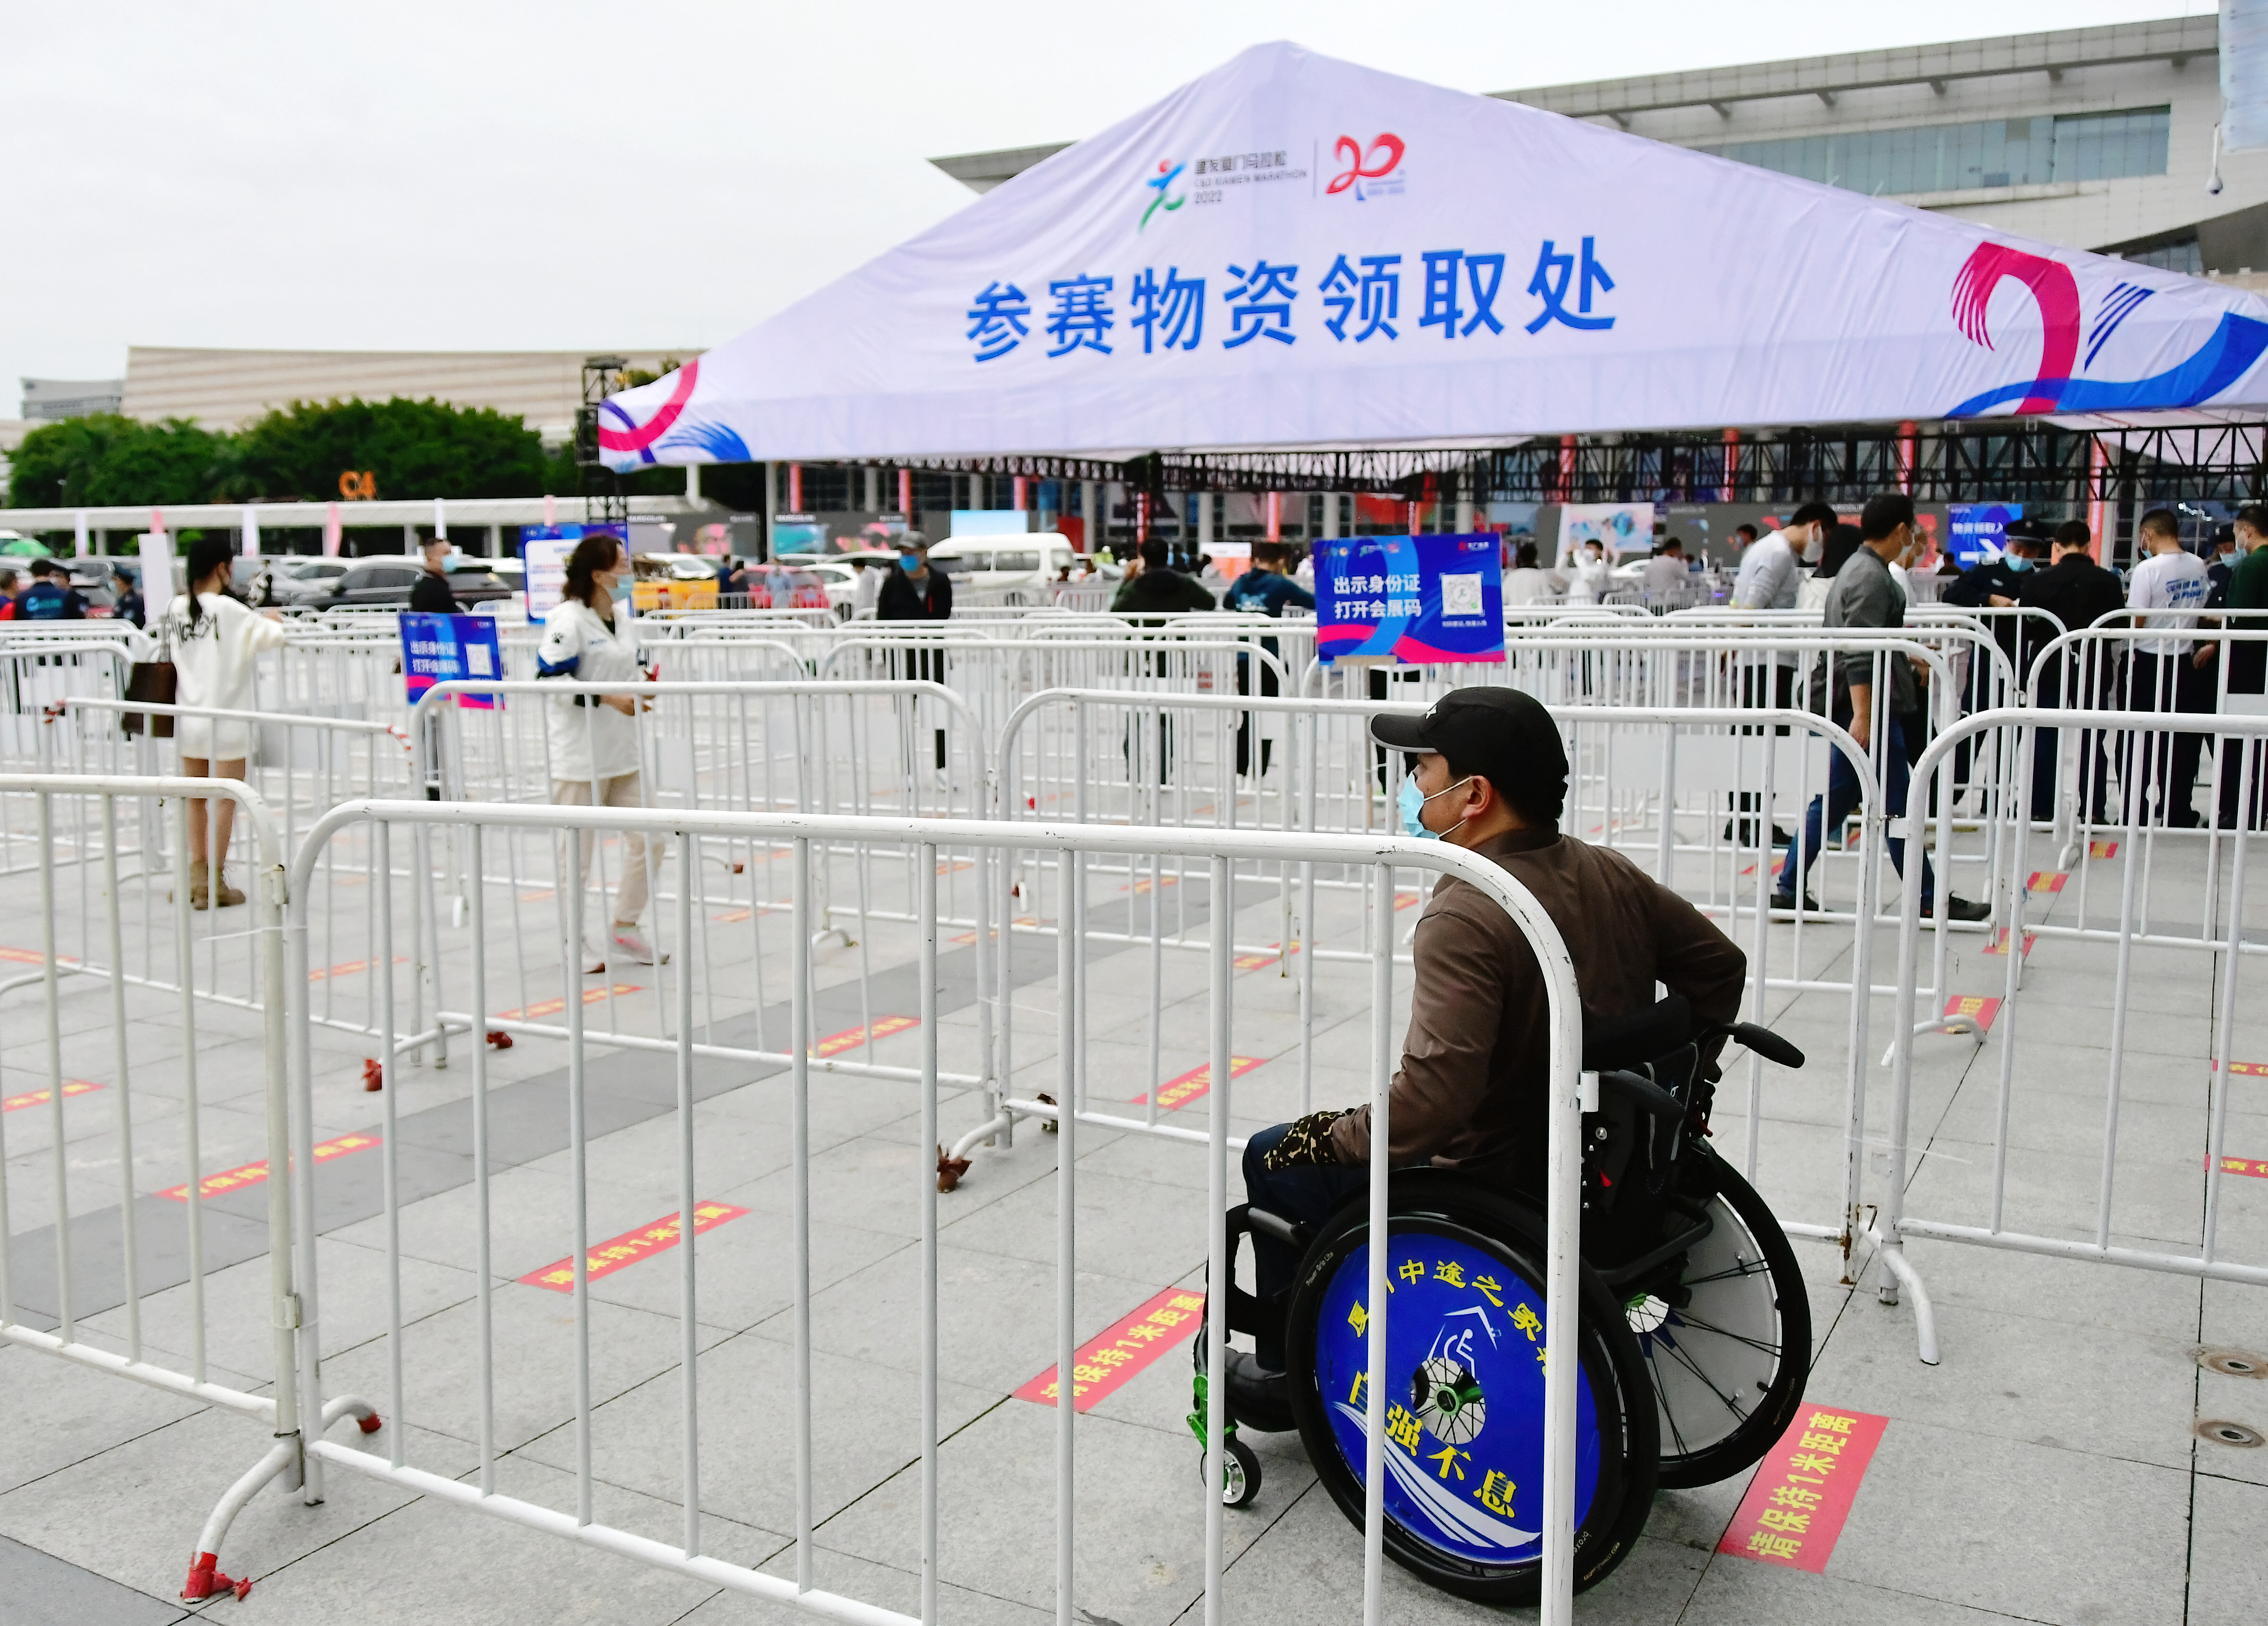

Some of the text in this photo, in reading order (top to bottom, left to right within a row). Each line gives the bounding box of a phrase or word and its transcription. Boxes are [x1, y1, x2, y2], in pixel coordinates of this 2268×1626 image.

[1253, 167, 1307, 181] MARATHON
[966, 236, 1616, 362] 参赛物资领取处
[1334, 574, 1422, 595] 出示身份证
[1746, 1412, 1857, 1560] 请保持1米距离
